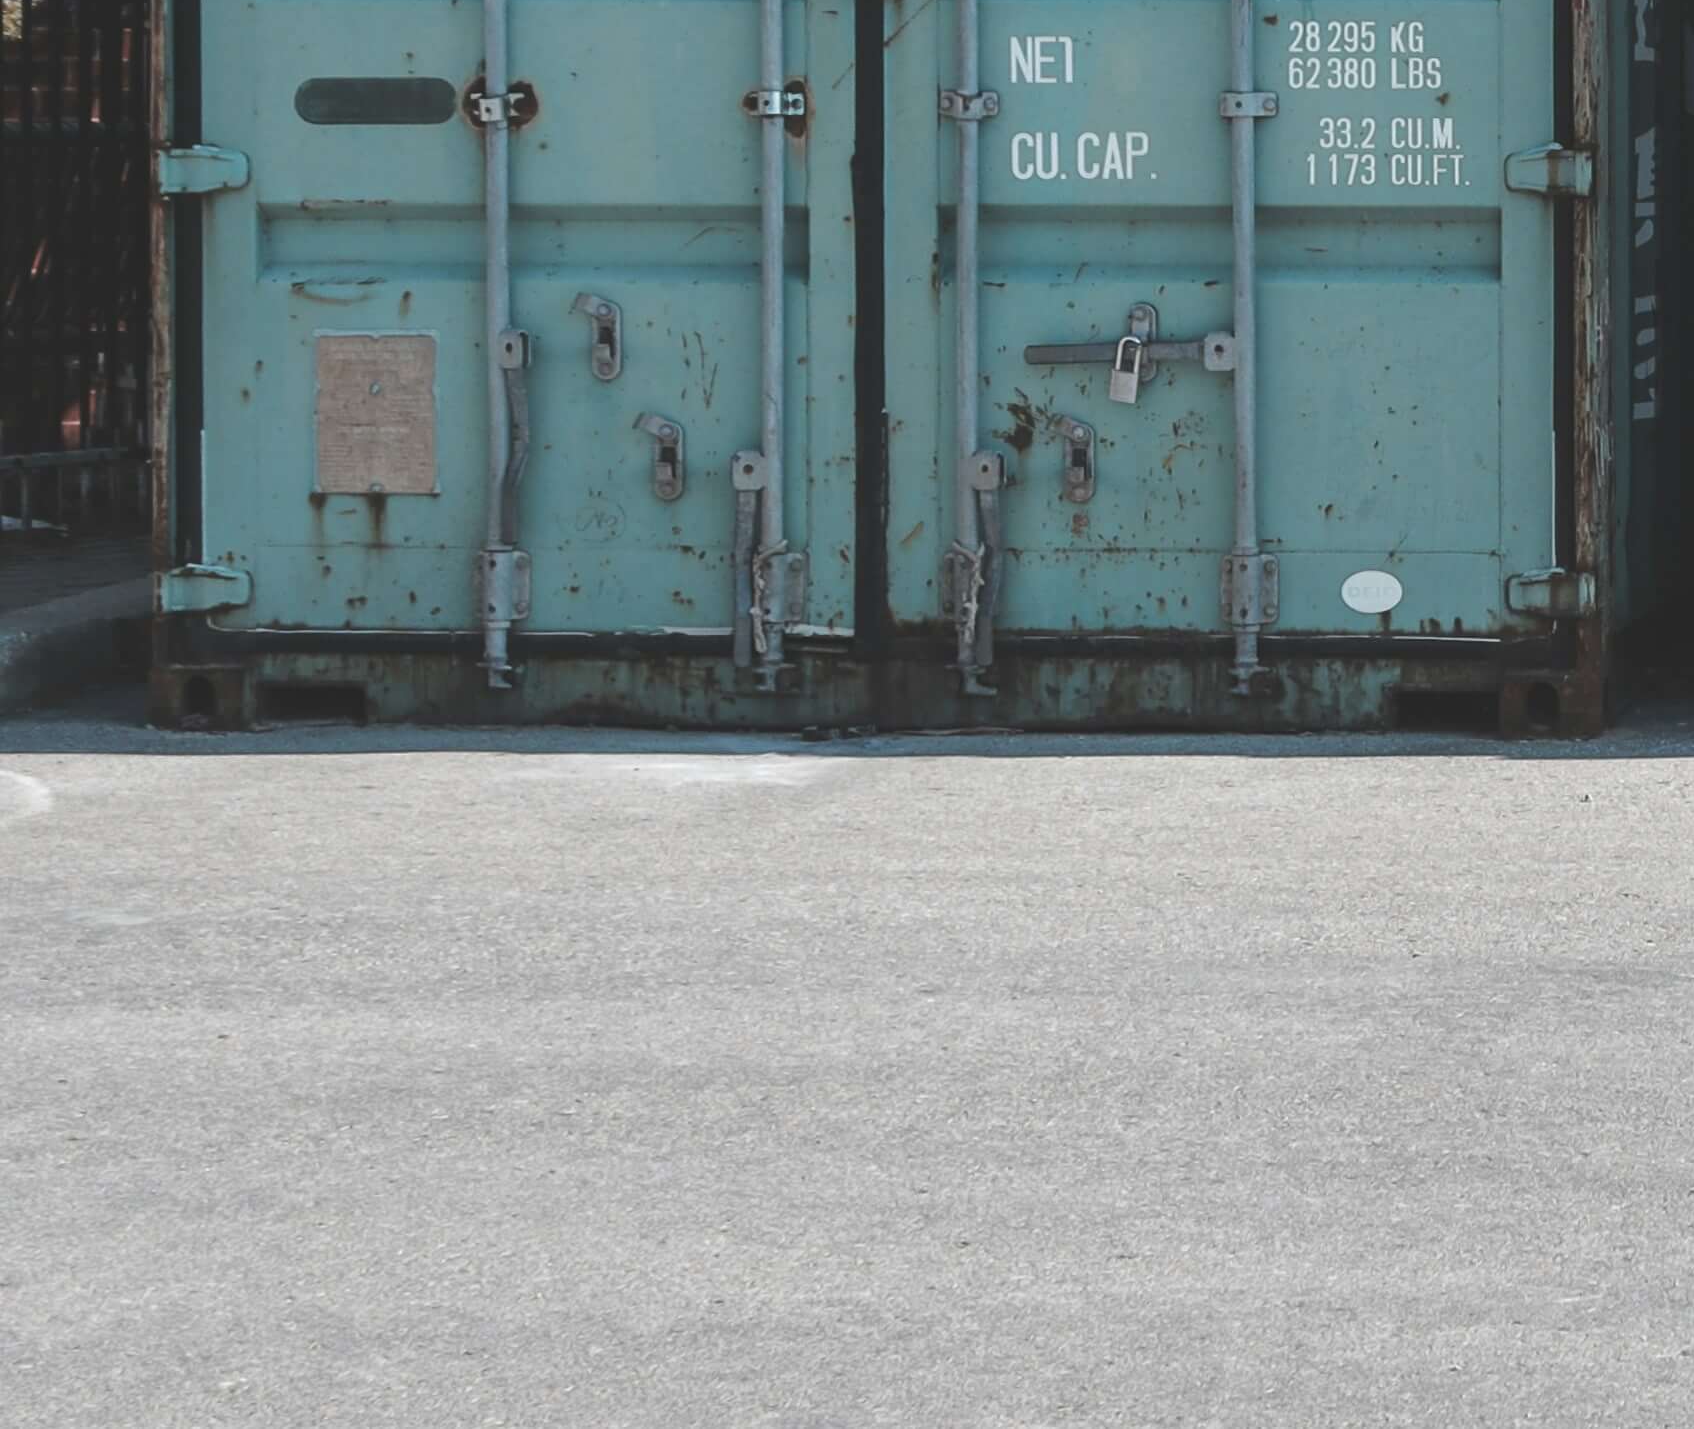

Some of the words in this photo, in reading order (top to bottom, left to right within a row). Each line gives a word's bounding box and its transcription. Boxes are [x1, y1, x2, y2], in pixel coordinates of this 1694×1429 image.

[1391, 21, 1424, 53] KG
[1391, 57, 1442, 89] LBS
[1319, 118, 1376, 149] 33.2
[1011, 132, 1067, 180] CU.
[1077, 132, 1158, 180] CAP.
